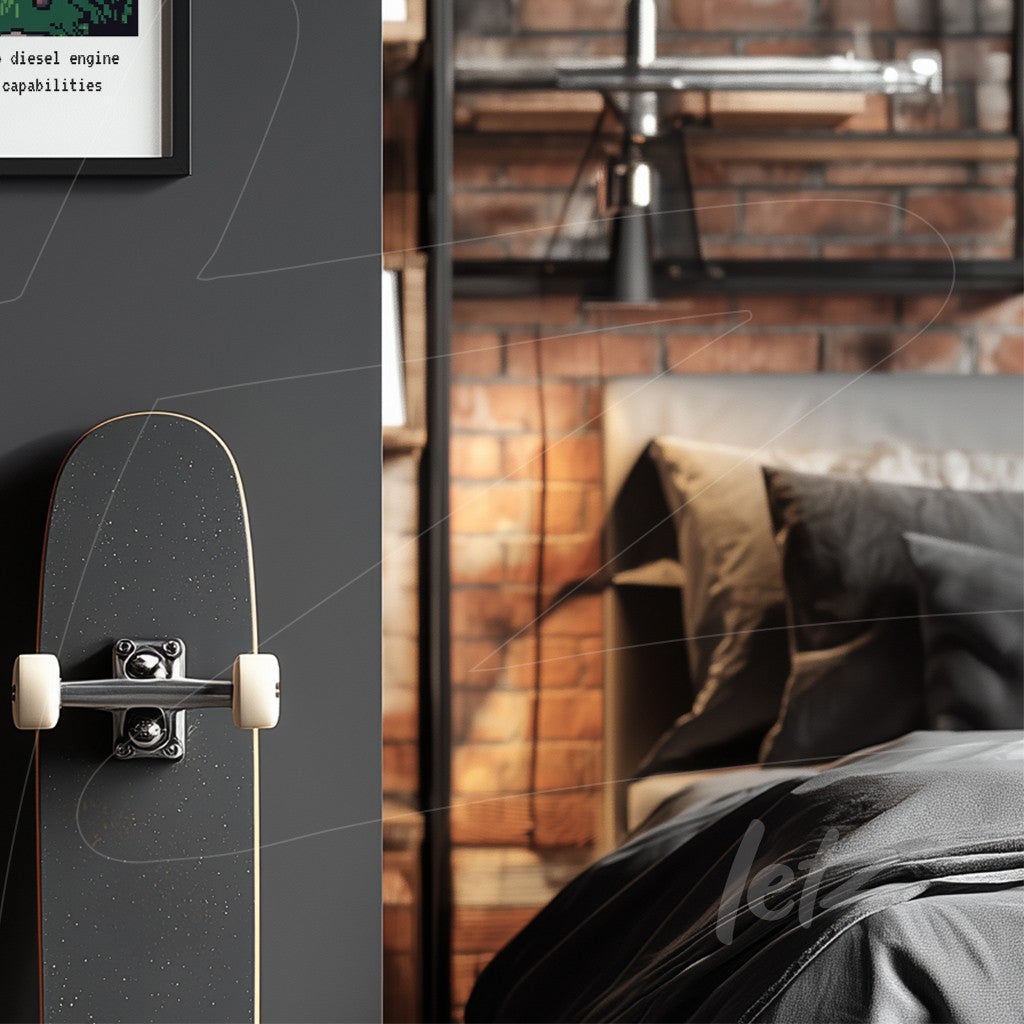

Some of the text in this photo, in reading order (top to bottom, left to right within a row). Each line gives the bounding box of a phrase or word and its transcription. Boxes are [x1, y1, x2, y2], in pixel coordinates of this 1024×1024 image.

[10, 50, 60, 66] diesel
[69, 50, 120, 68] engine
[1, 77, 103, 96] capabilities
